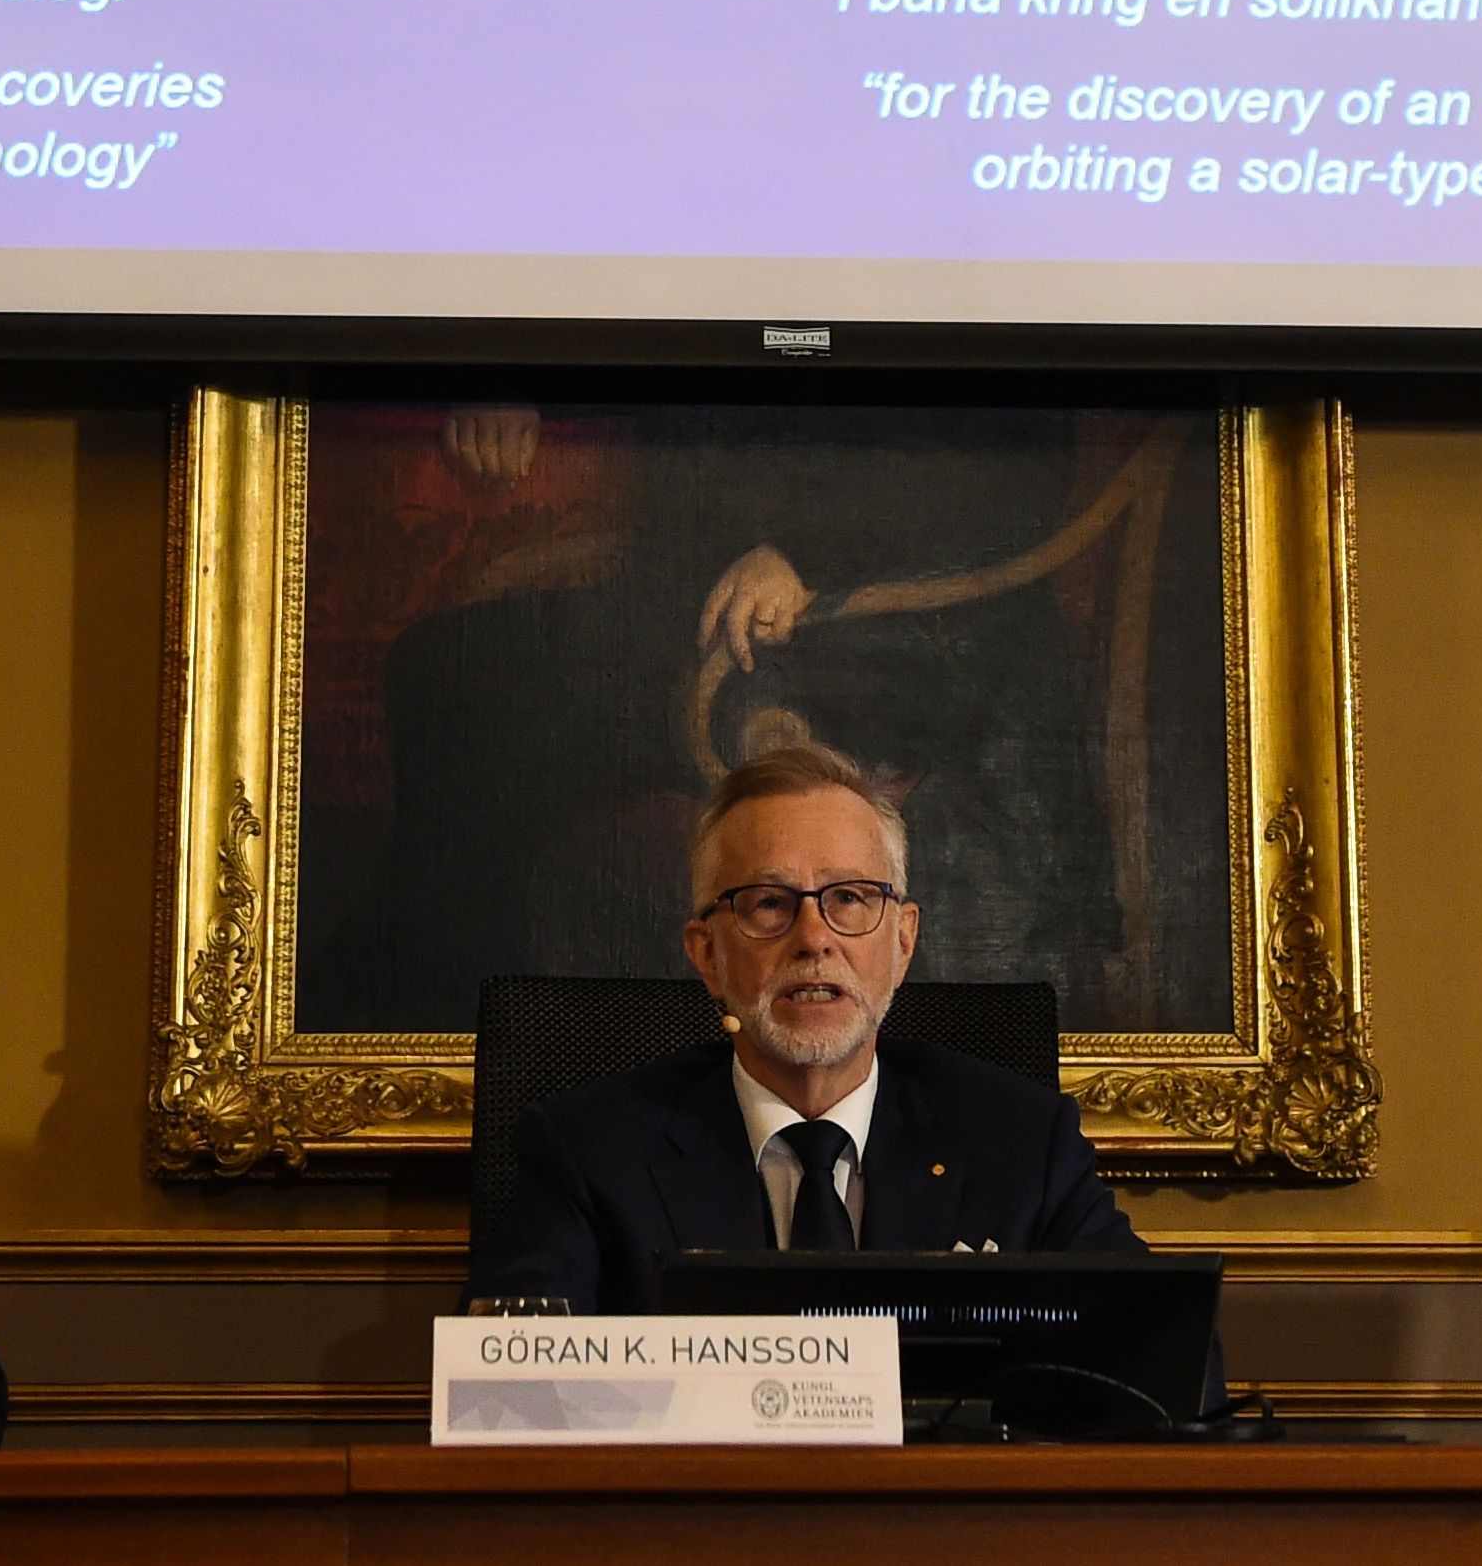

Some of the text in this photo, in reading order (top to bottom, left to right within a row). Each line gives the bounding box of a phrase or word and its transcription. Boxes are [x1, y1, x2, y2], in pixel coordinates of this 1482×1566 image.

[967, 72, 1051, 120] the
[1067, 74, 1326, 136] discovery
[1338, 78, 1396, 125] of
[1404, 89, 1471, 126] an
[972, 143, 1173, 203] orbiting
[1187, 157, 1222, 193] a
[480, 1329, 850, 1365] GÖRAN K. HANSSON
